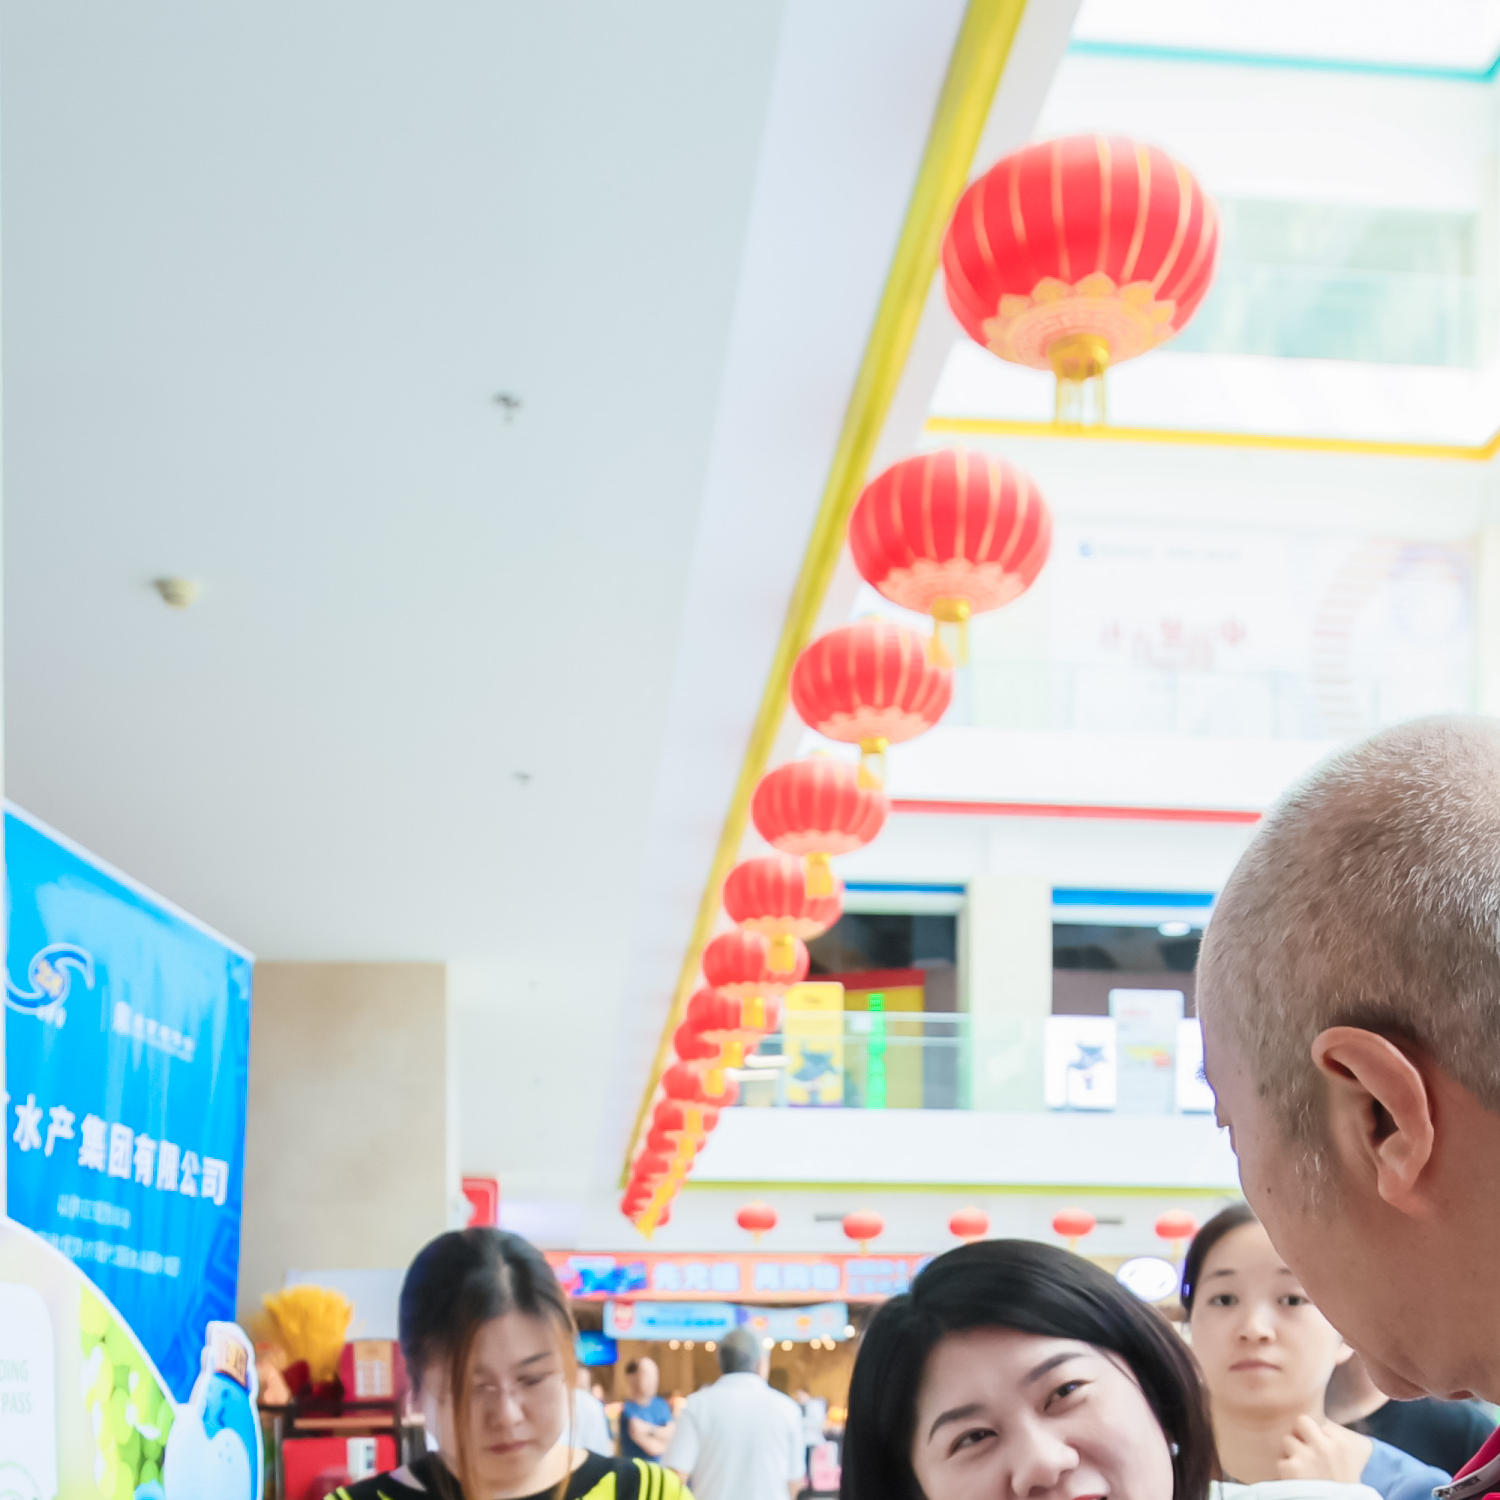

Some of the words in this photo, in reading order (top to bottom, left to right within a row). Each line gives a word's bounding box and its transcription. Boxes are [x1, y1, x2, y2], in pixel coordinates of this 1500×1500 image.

[3, 1092, 228, 1206] 水产集团有限公司
[1, 1392, 32, 1414] PASS
